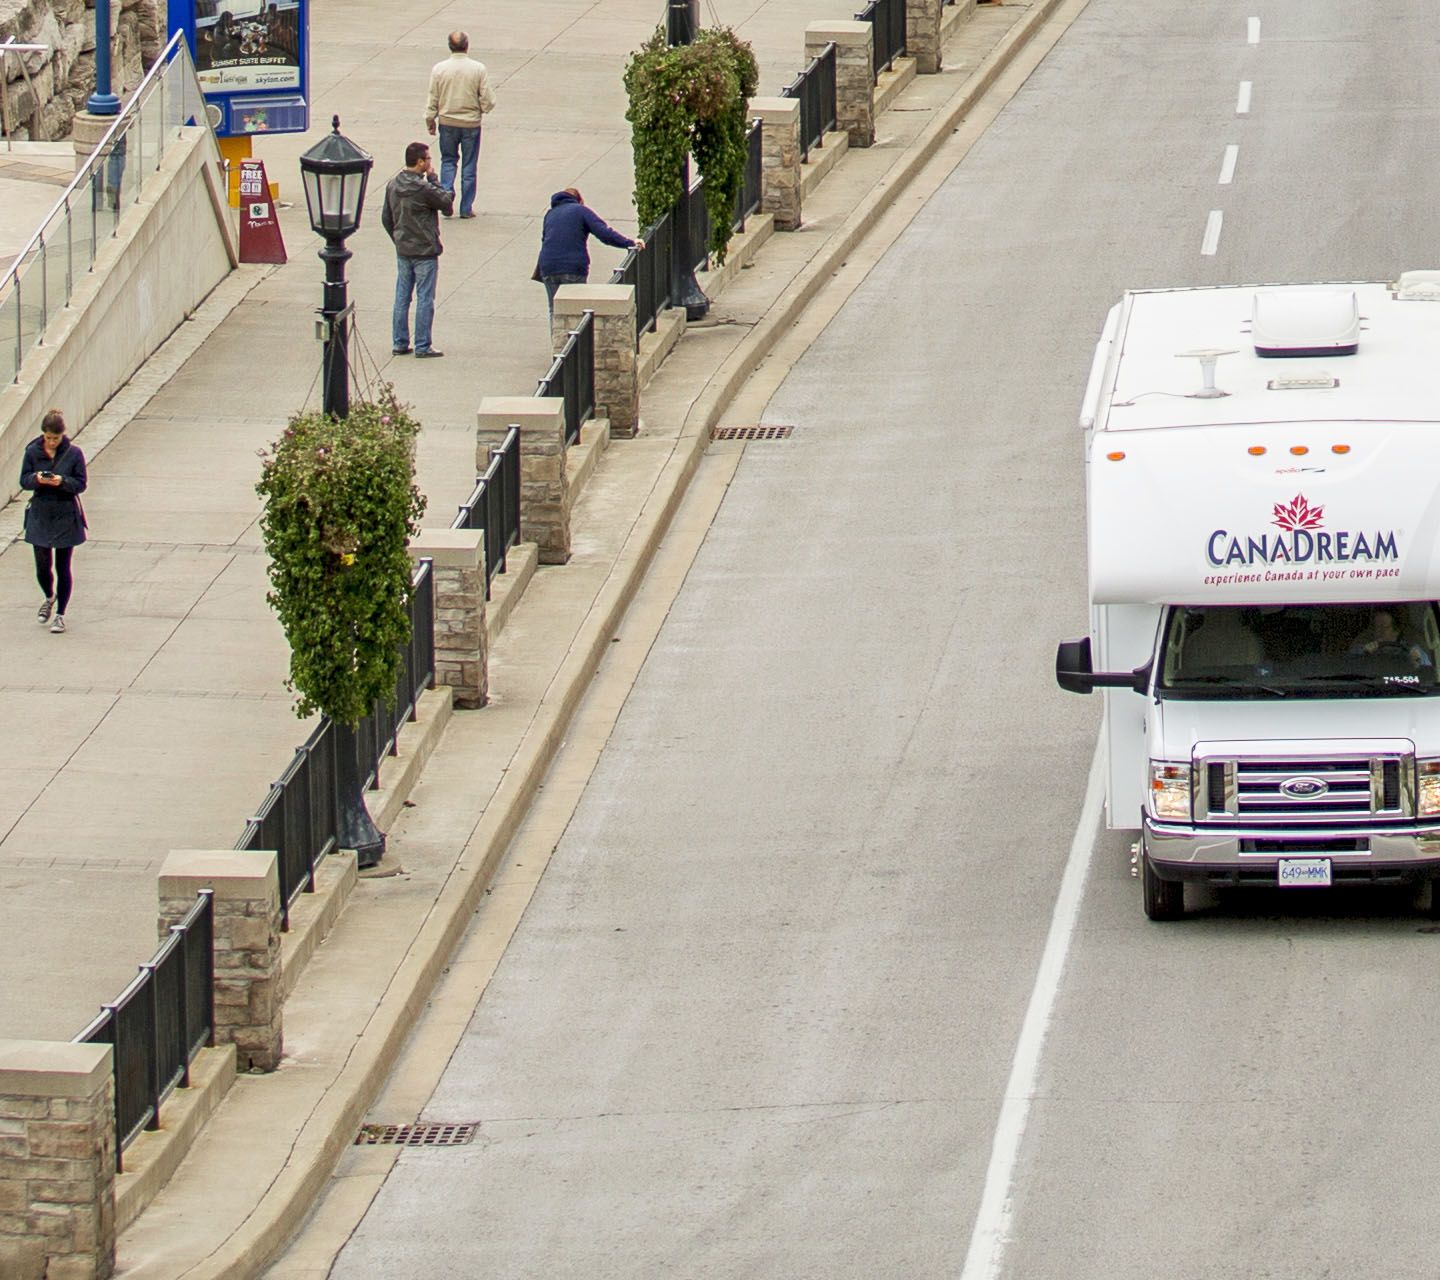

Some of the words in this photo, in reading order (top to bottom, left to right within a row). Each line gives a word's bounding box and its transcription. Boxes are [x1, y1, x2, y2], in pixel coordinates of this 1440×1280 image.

[260, 56, 287, 65] BUFFET
[255, 76, 295, 85] skylon.com
[241, 170, 262, 180] FREE
[1204, 572, 1261, 587] experience
[1264, 569, 1304, 582] Canada
[1307, 569, 1319, 580] at
[1322, 569, 1347, 582] your
[1349, 568, 1373, 579] own
[1375, 568, 1401, 580] pace
[1281, 866, 1302, 880] 649
